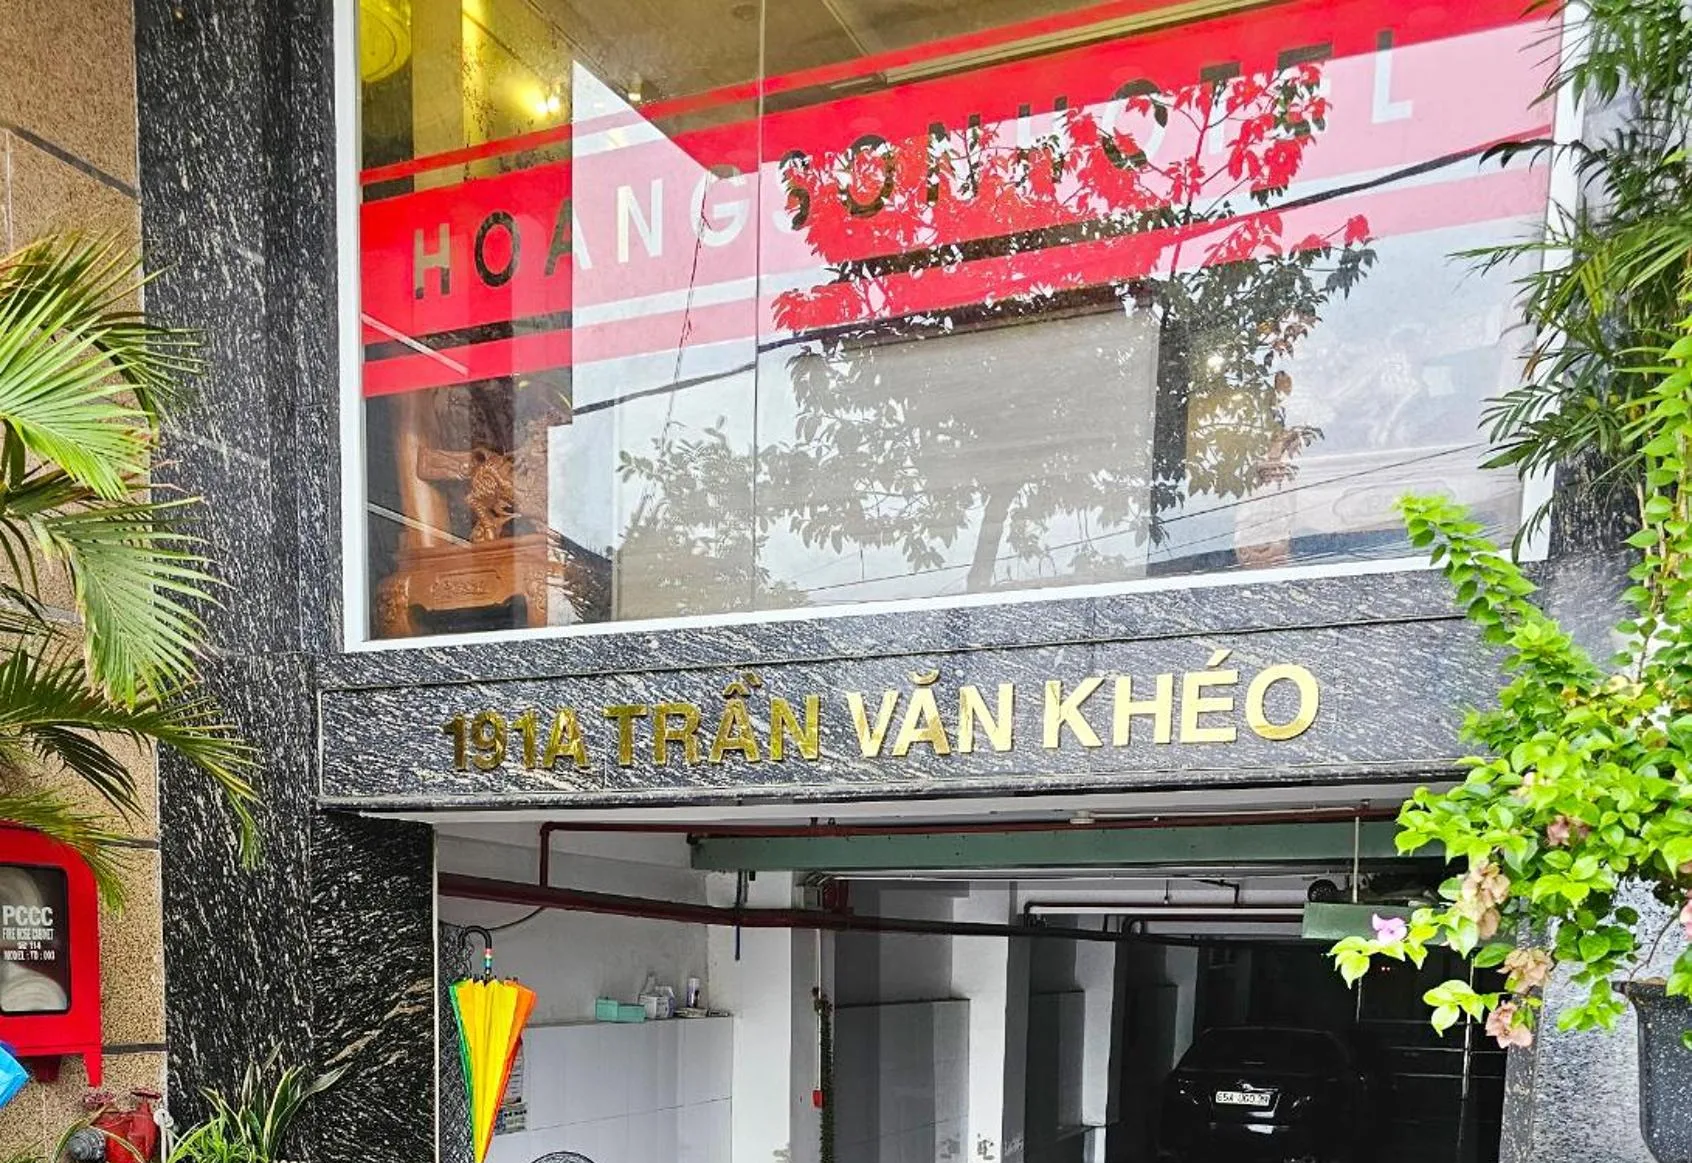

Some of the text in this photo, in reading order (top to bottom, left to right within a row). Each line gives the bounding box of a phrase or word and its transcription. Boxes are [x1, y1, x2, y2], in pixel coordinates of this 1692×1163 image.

[443, 648, 1321, 772] 191A TRẦN VĂN KHÉO
[2, 904, 54, 926] PCCC
